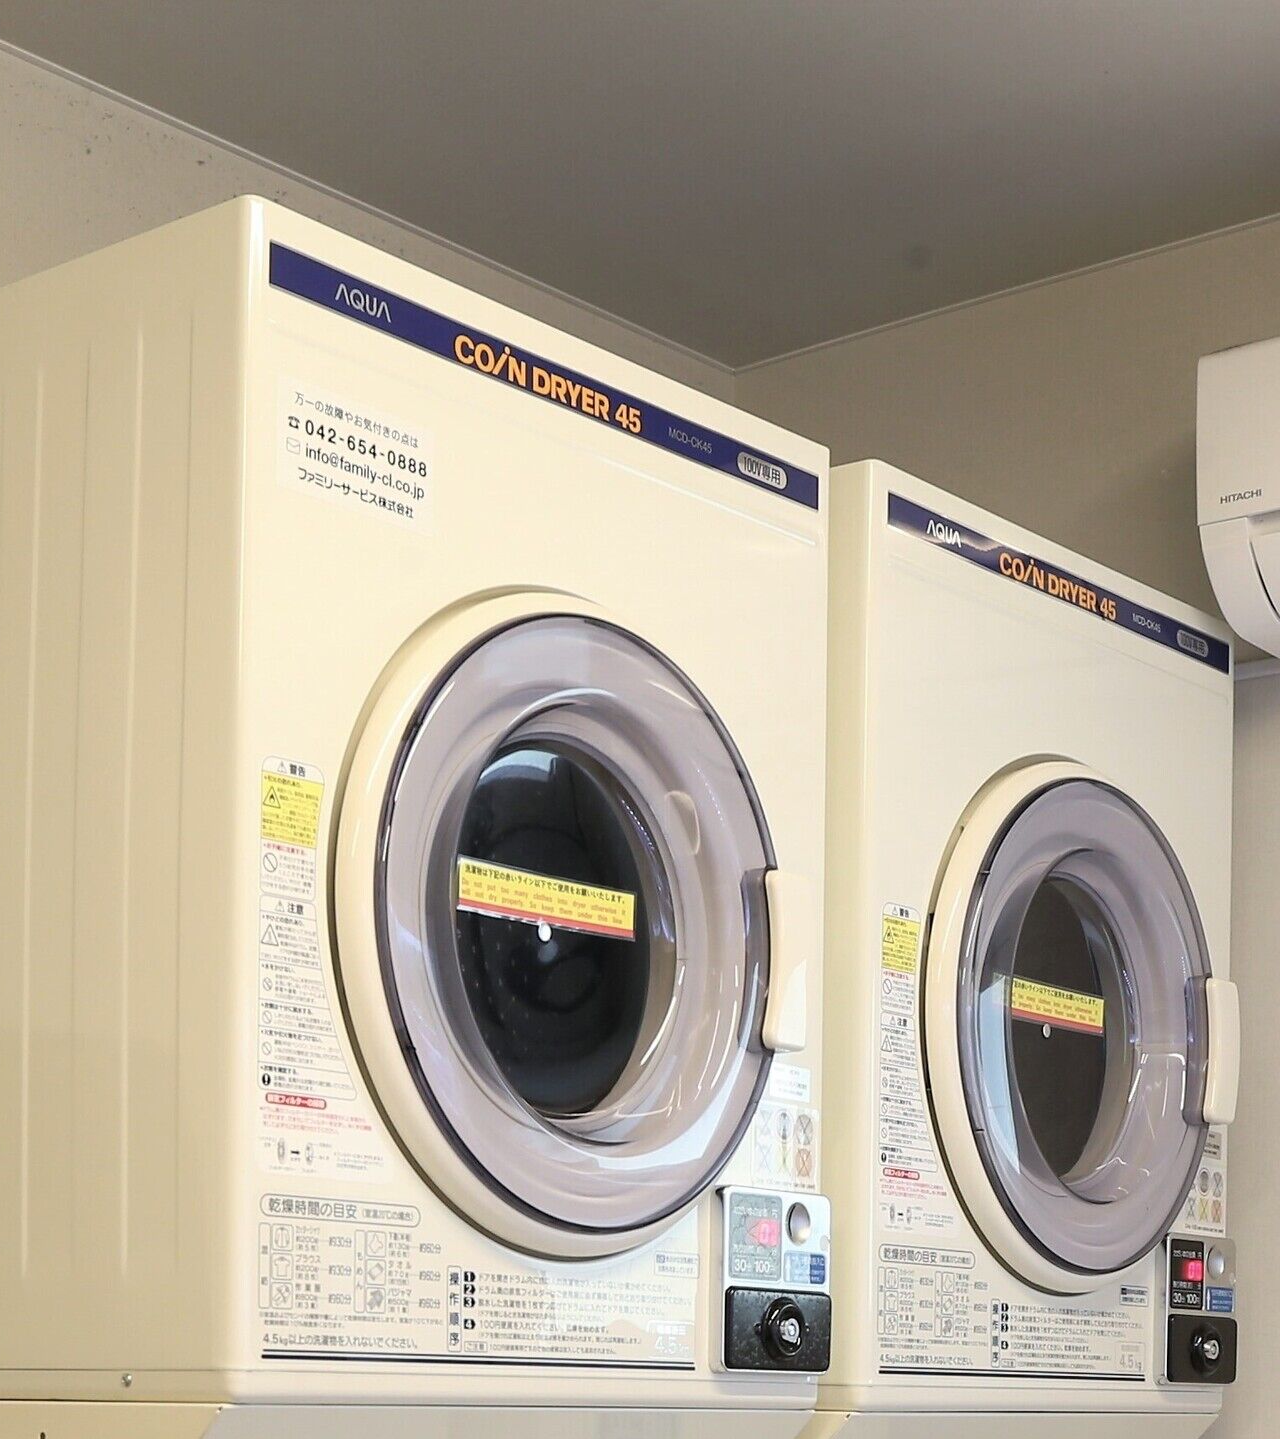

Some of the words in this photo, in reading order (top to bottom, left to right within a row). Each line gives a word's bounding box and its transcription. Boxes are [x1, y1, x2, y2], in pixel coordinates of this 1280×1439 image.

[335, 283, 392, 324] AQUA
[453, 335, 527, 388] COIN
[532, 366, 610, 422] DRYER
[615, 404, 643, 434] 45
[294, 391, 419, 449] 万一の故障やお気付きの点は
[668, 426, 713, 455] MCD-CK45
[305, 419, 427, 478] 042-654-0888
[305, 443, 425, 500] info@family-cl.co.jp
[743, 455, 782, 486] 100V専用
[297, 466, 414, 519] ファミリーサービス株式会社
[1220, 488, 1262, 504] HITACHI
[926, 518, 963, 549] AQUA
[998, 551, 1045, 590] COIN
[1047, 572, 1098, 613] DRYER
[1099, 597, 1117, 622] 45
[287, 901, 304, 915] 注意
[269, 1198, 358, 1220] 乾燥時間の目安
